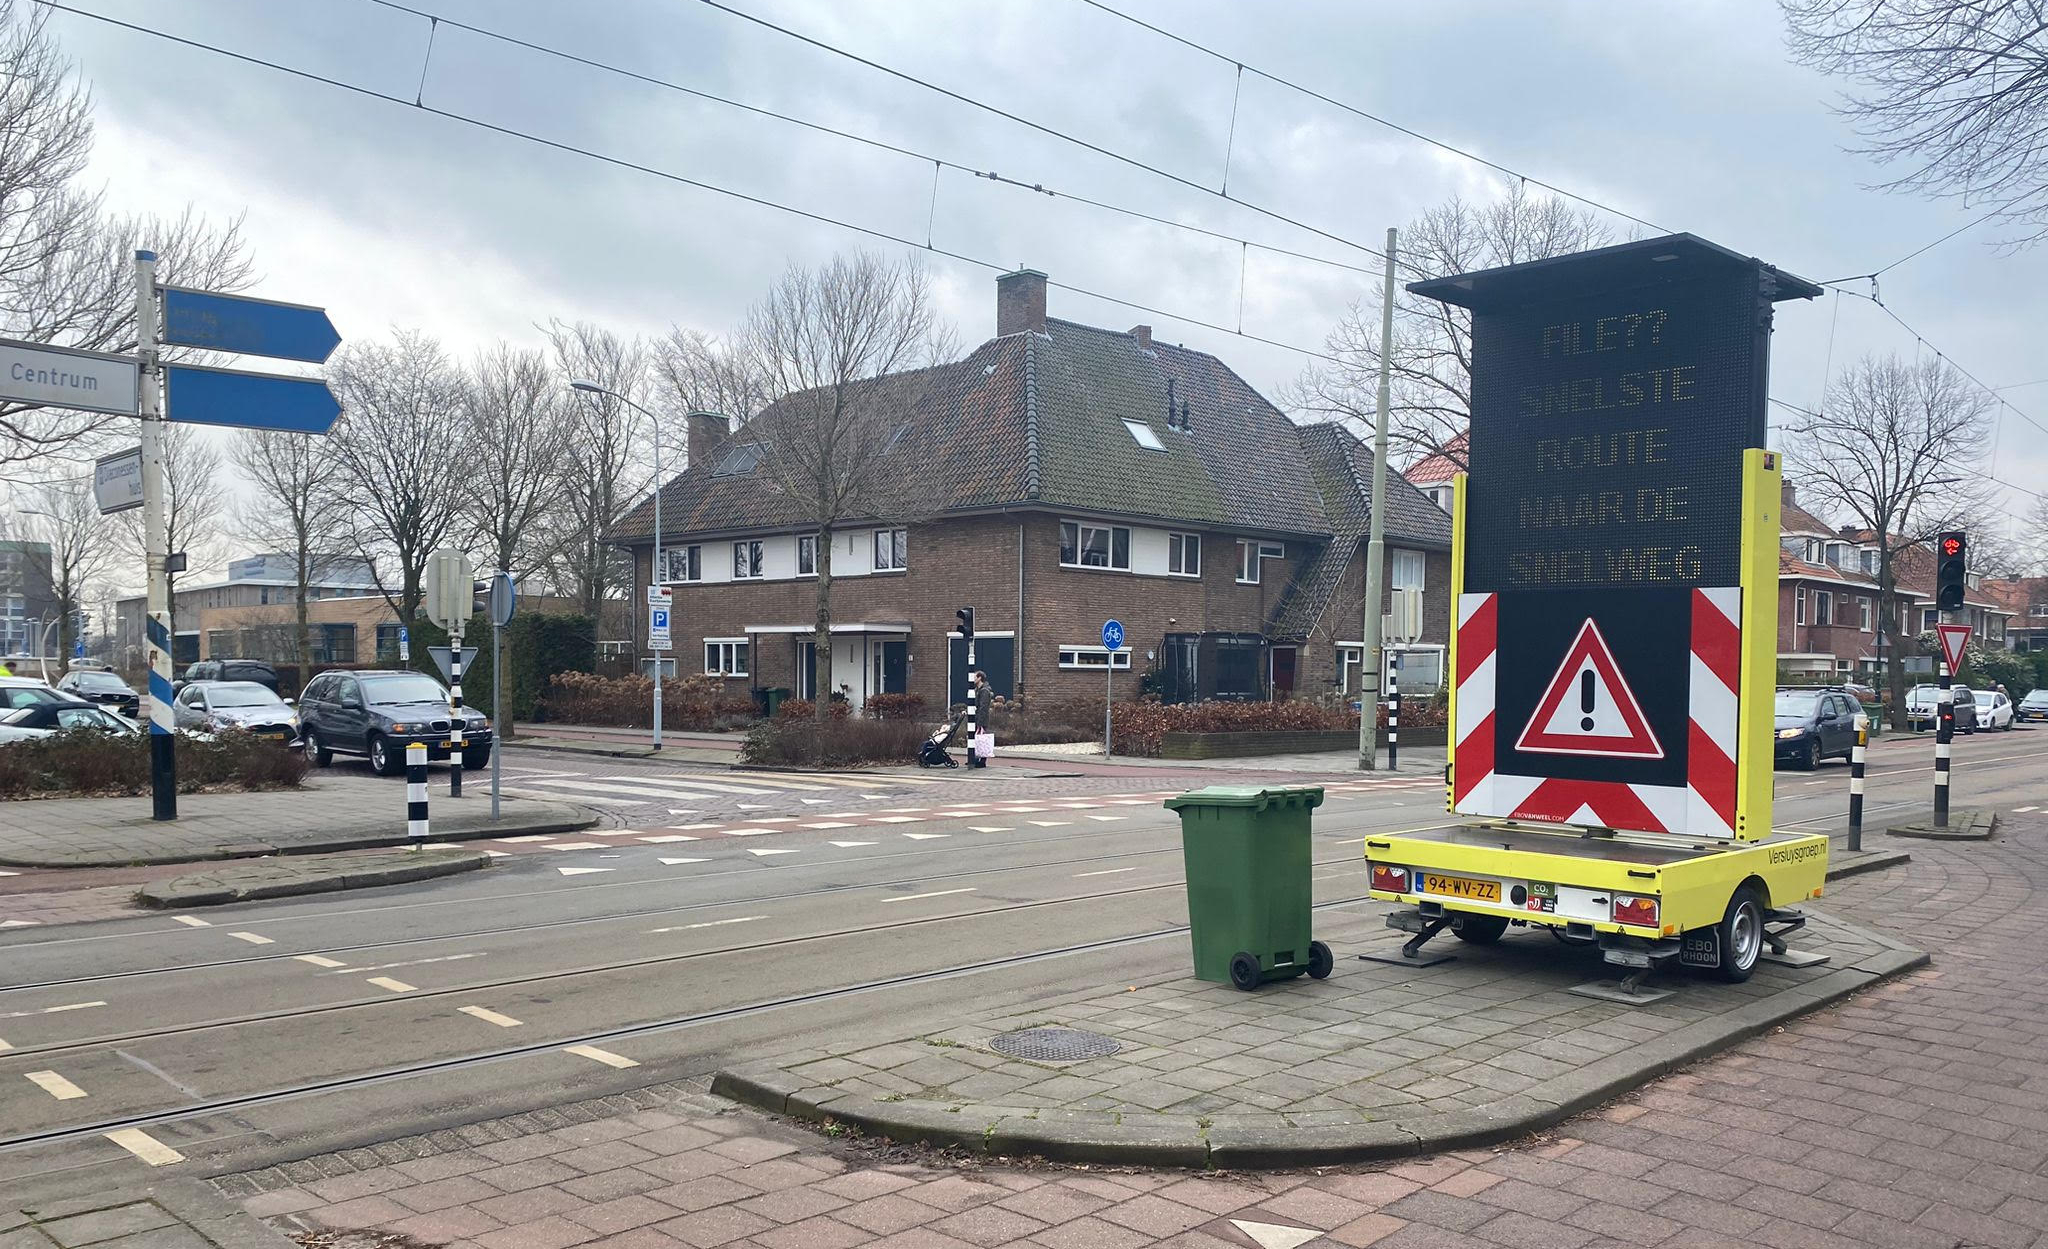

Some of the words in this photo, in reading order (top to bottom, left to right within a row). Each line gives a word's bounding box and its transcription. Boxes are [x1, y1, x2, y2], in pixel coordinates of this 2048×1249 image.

[1543, 308, 1668, 359] FILE??
[11, 362, 98, 391] Centrum
[1519, 365, 1697, 418] SNELSTE
[1536, 428, 1669, 472] ROUTE
[1519, 490, 1627, 530] NAAR
[1635, 485, 1689, 523] DE
[1509, 545, 1702, 584] SNELWEG
[656, 613, 665, 625] P
[1768, 840, 1827, 865] Versluysgroep.nl
[1429, 877, 1494, 899] 94-WV-ZZ
[1682, 951, 1717, 963] RHOON
[1687, 939, 1713, 952] EBO
